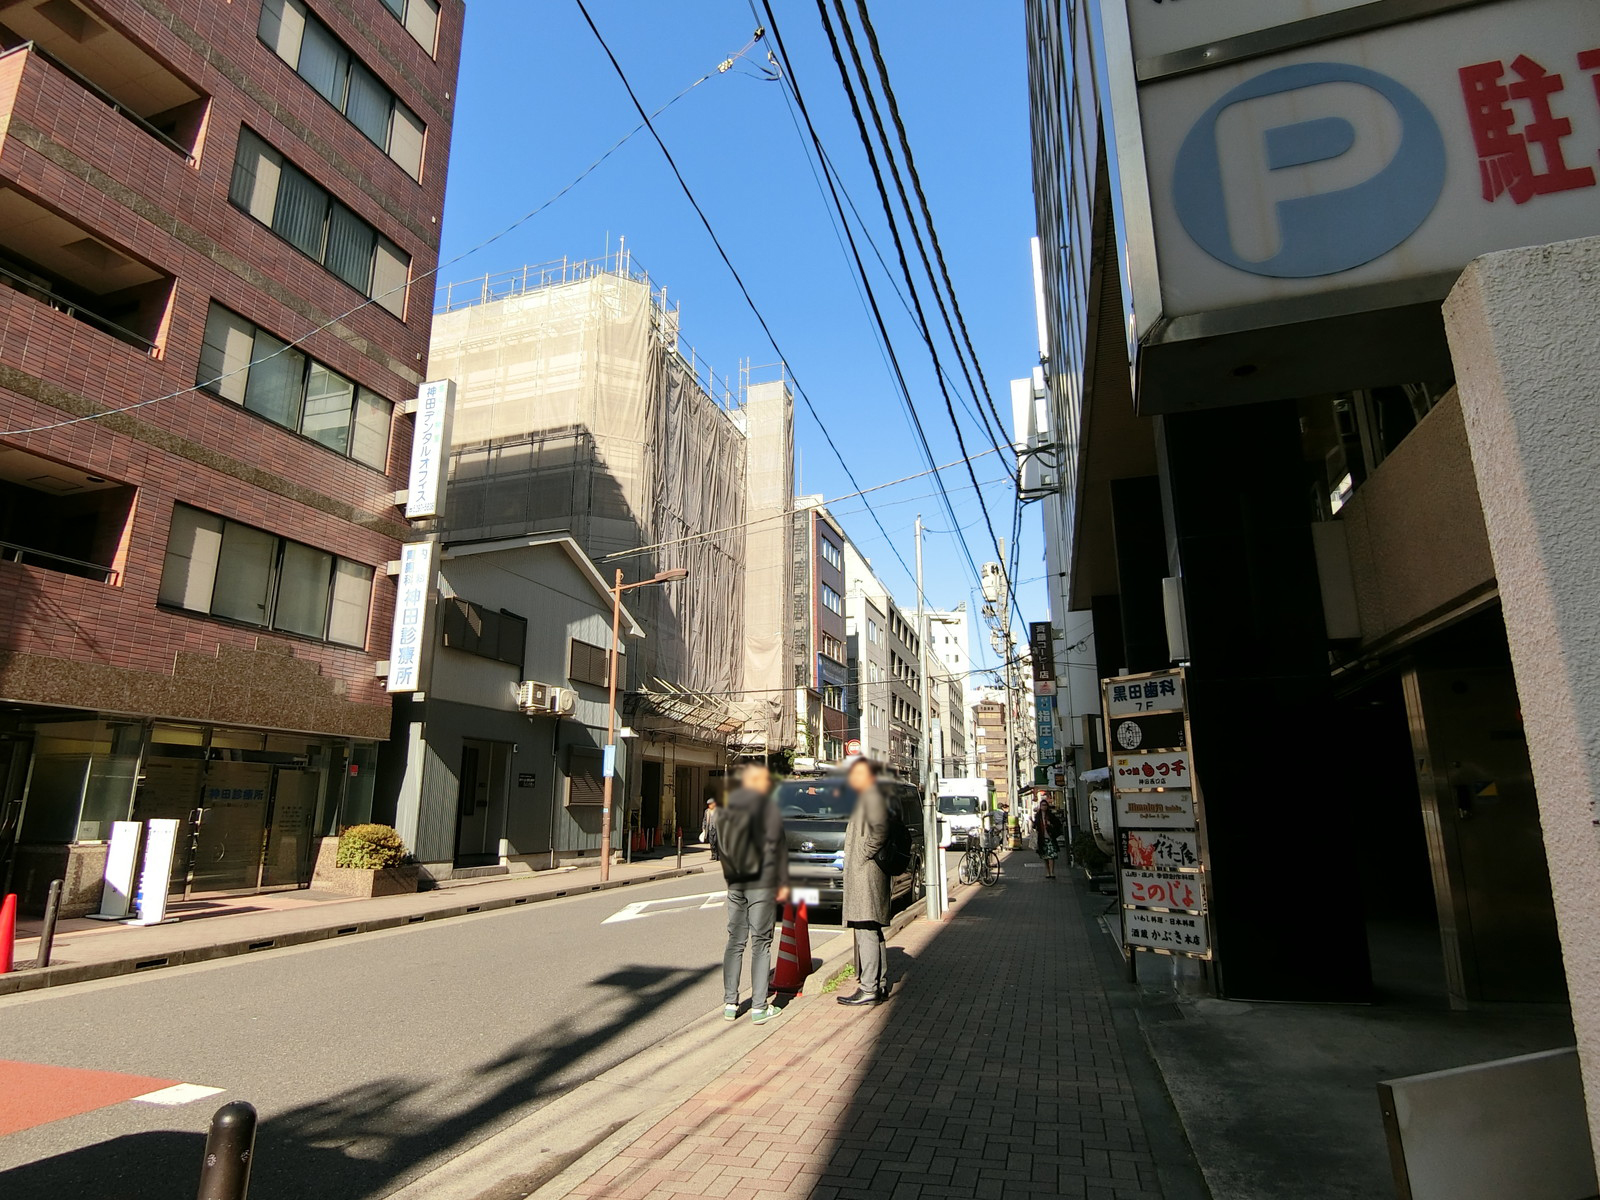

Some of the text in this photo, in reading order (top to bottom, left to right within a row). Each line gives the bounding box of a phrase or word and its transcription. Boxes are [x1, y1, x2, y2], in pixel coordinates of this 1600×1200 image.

[1215, 80, 1404, 264] P
[1458, 47, 1600, 206] 駐
[416, 386, 437, 503] 神田デンタルオフィス
[395, 588, 421, 685] 神田診療所
[1113, 679, 1175, 702] 黒田歯科
[1141, 759, 1186, 777] もつ千
